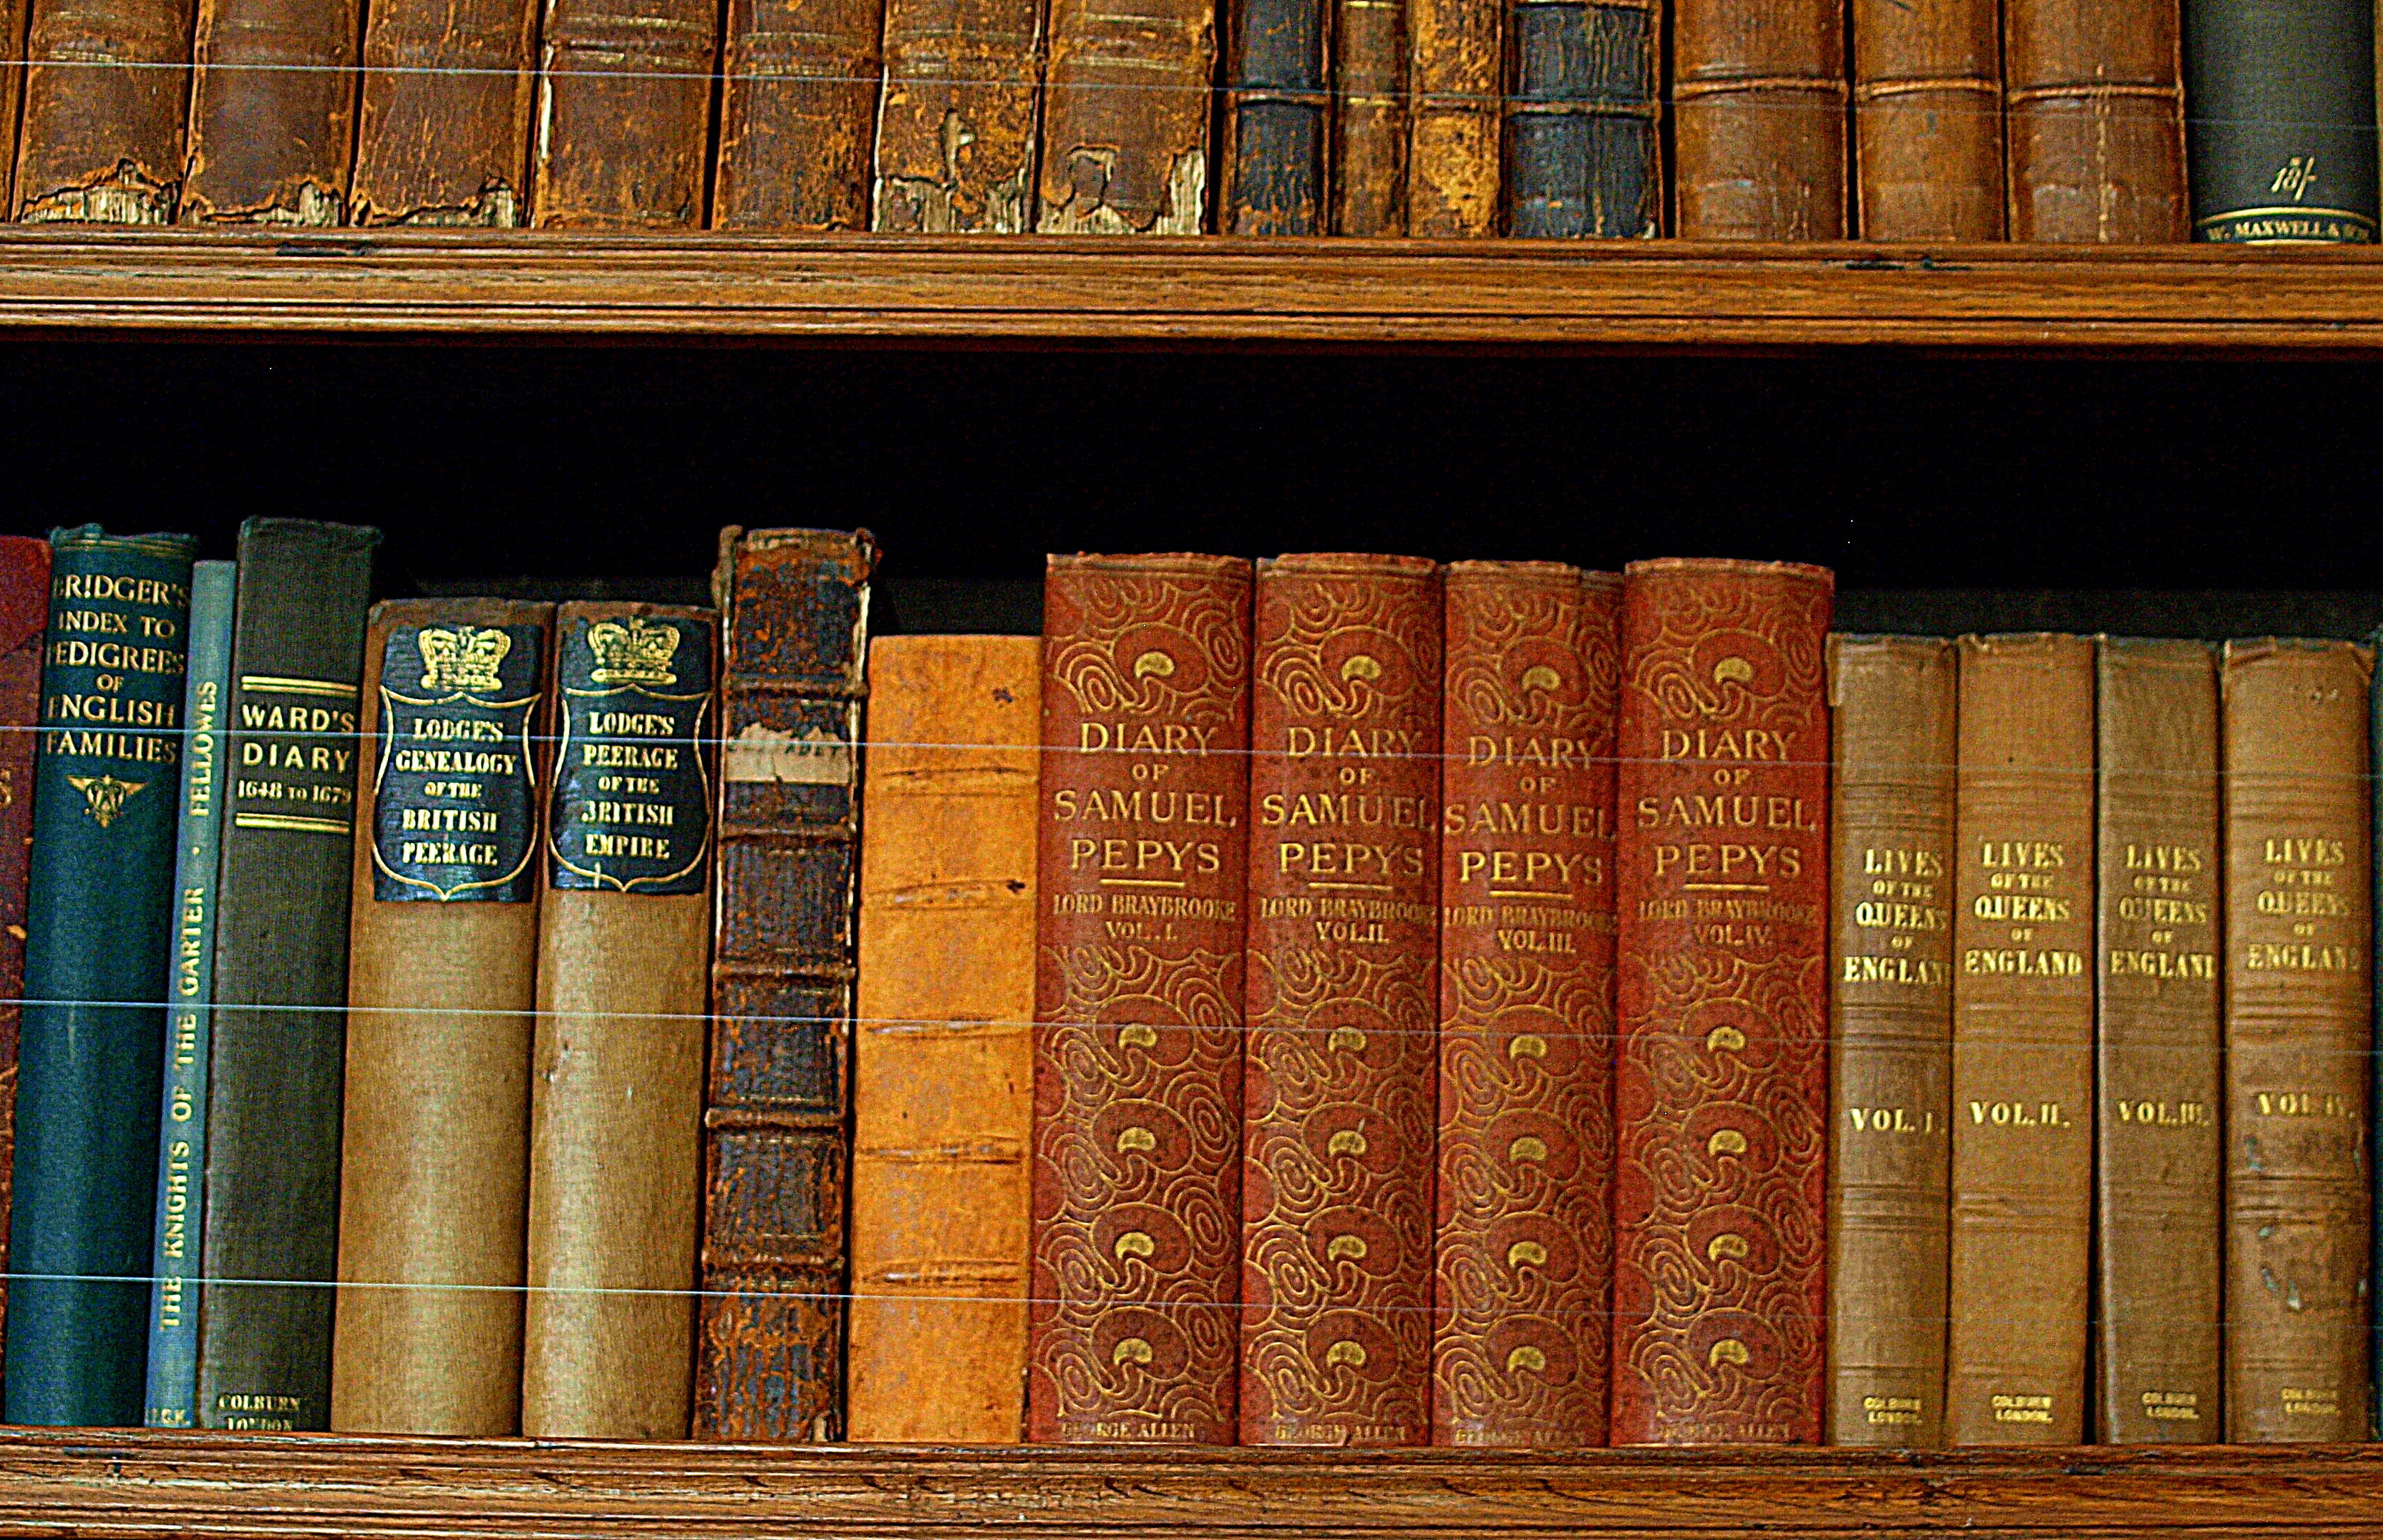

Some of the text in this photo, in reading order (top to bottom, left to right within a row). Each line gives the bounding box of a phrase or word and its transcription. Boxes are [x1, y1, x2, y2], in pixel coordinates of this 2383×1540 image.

[59, 611, 175, 638] INDEX TO
[97, 674, 123, 693] OF
[49, 694, 175, 726] ENGLISH
[242, 704, 355, 733] WARD'S
[47, 731, 176, 763] FAMILIES
[1079, 722, 1216, 756] DIARY
[1288, 727, 1423, 759] DIARY
[1661, 729, 1797, 761] DIARY
[243, 742, 349, 774] DIARY
[395, 750, 517, 775] GENEALOGY
[583, 744, 678, 769] PEERAGE
[1467, 735, 1598, 770] DIARY
[598, 776, 659, 794] OF THE
[1131, 763, 1169, 781] OF
[1339, 767, 1377, 786] OF
[1520, 776, 1556, 794] OF
[1713, 768, 1749, 786] OF
[238, 780, 283, 799] 1648
[424, 781, 482, 798] OF THE
[402, 809, 498, 832] BRITISH
[1054, 790, 1236, 828] SAMUEL
[1262, 794, 1436, 832] SAMUEL
[1444, 801, 1616, 842] SAMUEL
[1636, 794, 1818, 832] SAMUEL
[402, 842, 498, 866] PEERAGE
[585, 834, 670, 859] EMPIRE
[1070, 839, 1220, 874] PEPYS
[1280, 843, 1425, 876] PEPYS
[1982, 842, 2063, 868] LIVES
[2126, 844, 2201, 872] LIVES
[2265, 838, 2345, 865] LIVES
[1460, 851, 1603, 885] PEPYS
[1654, 844, 1802, 877] PEPYS
[1865, 849, 1943, 876] LIVES
[1053, 895, 1102, 915] LORD
[1261, 897, 1312, 918] LORD
[1974, 895, 2071, 921] QUEENS
[2119, 897, 2208, 923] QUEENS
[2011, 927, 2033, 942] OF
[1844, 956, 1951, 985] ENGLAN
[1964, 950, 2082, 975] ENGLAND
[160, 682, 217, 1331] THE KNIGHTS OF THE GARTER FELLOWES
[218, 1395, 300, 1412] COLBURN
[1062, 1422, 1131, 1438] GERGE
